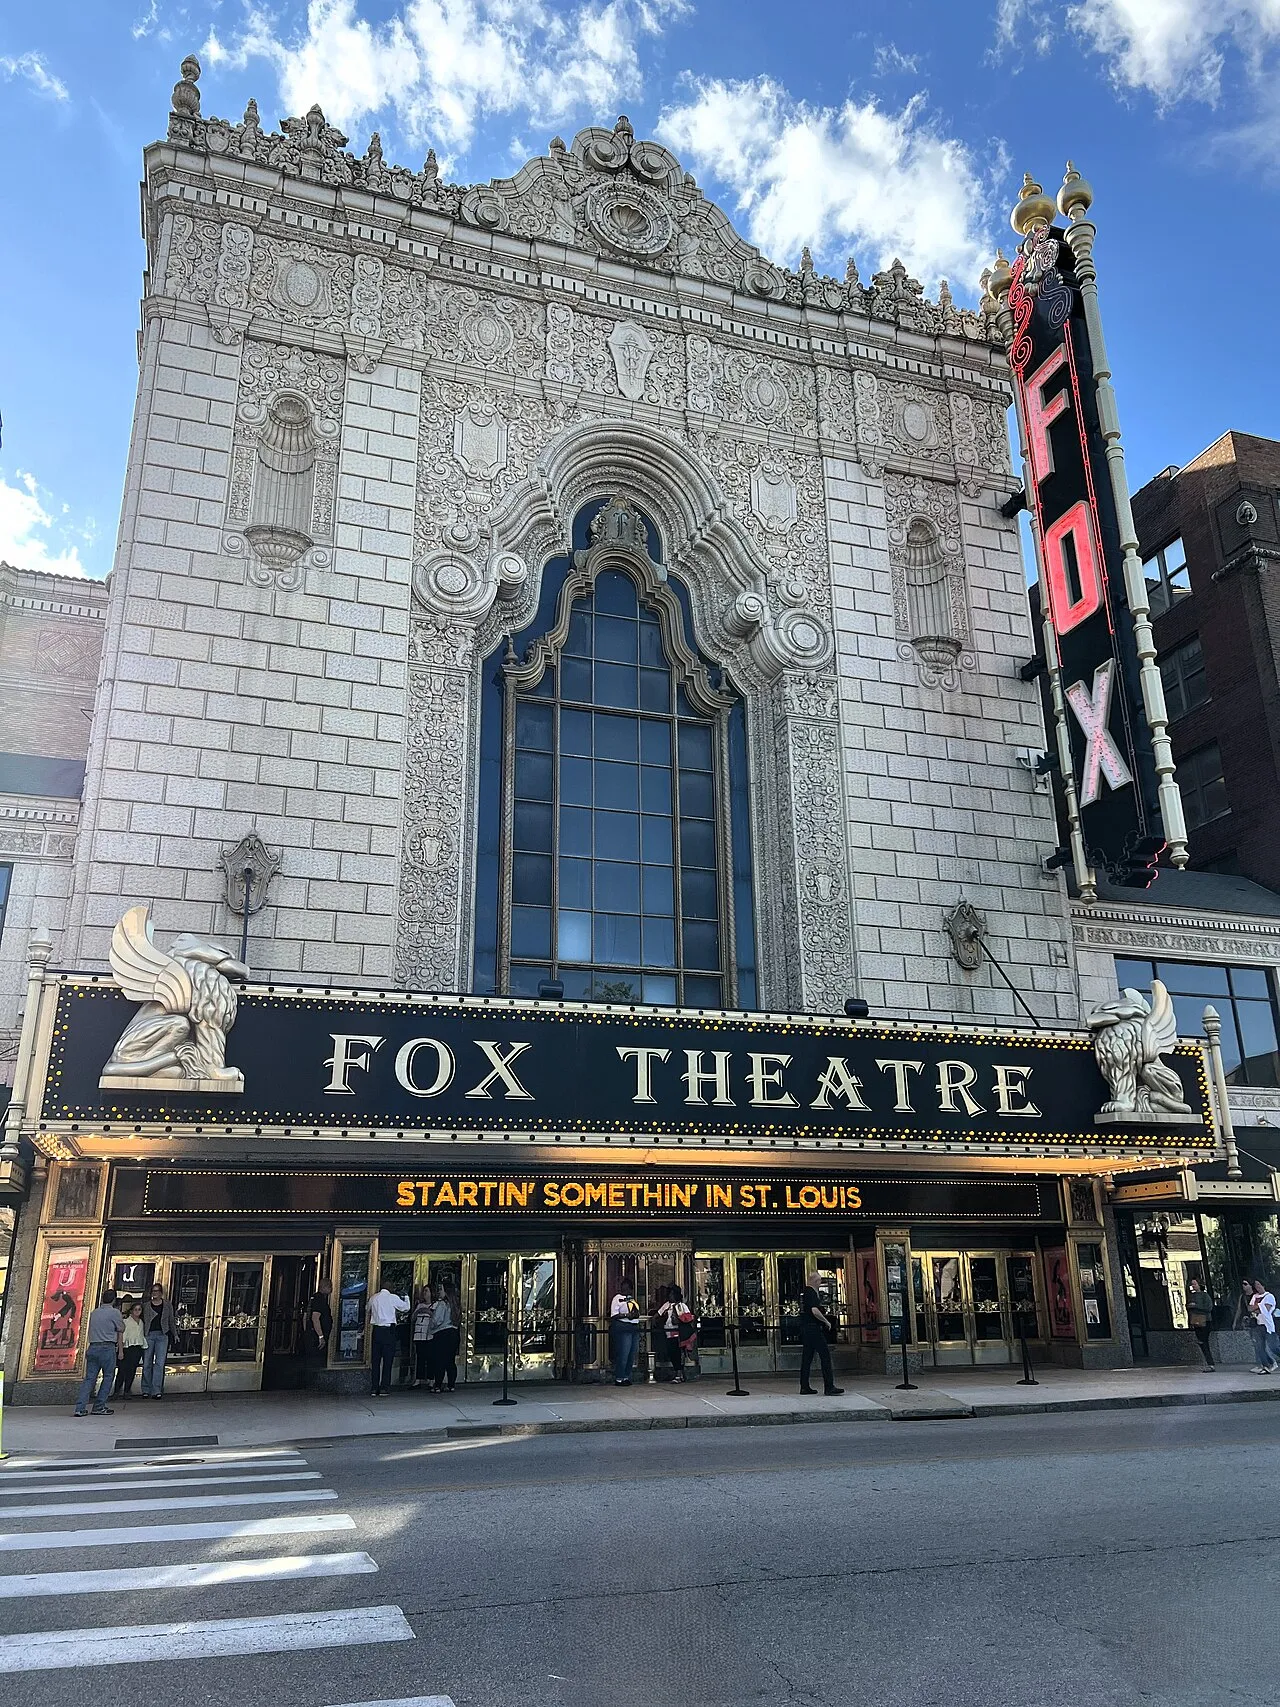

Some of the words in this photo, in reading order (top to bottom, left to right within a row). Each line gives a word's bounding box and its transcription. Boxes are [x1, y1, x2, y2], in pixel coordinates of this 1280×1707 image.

[1025, 343, 1133, 808] FOX
[323, 1033, 535, 1101] FOX
[615, 1046, 1042, 1118] THEATRE
[396, 1181, 535, 1207] STARTIN'
[543, 1182, 698, 1208] SOMETHIN'
[706, 1184, 732, 1208] IN
[739, 1185, 778, 1208] ST.
[786, 1186, 862, 1209] LOUIS
